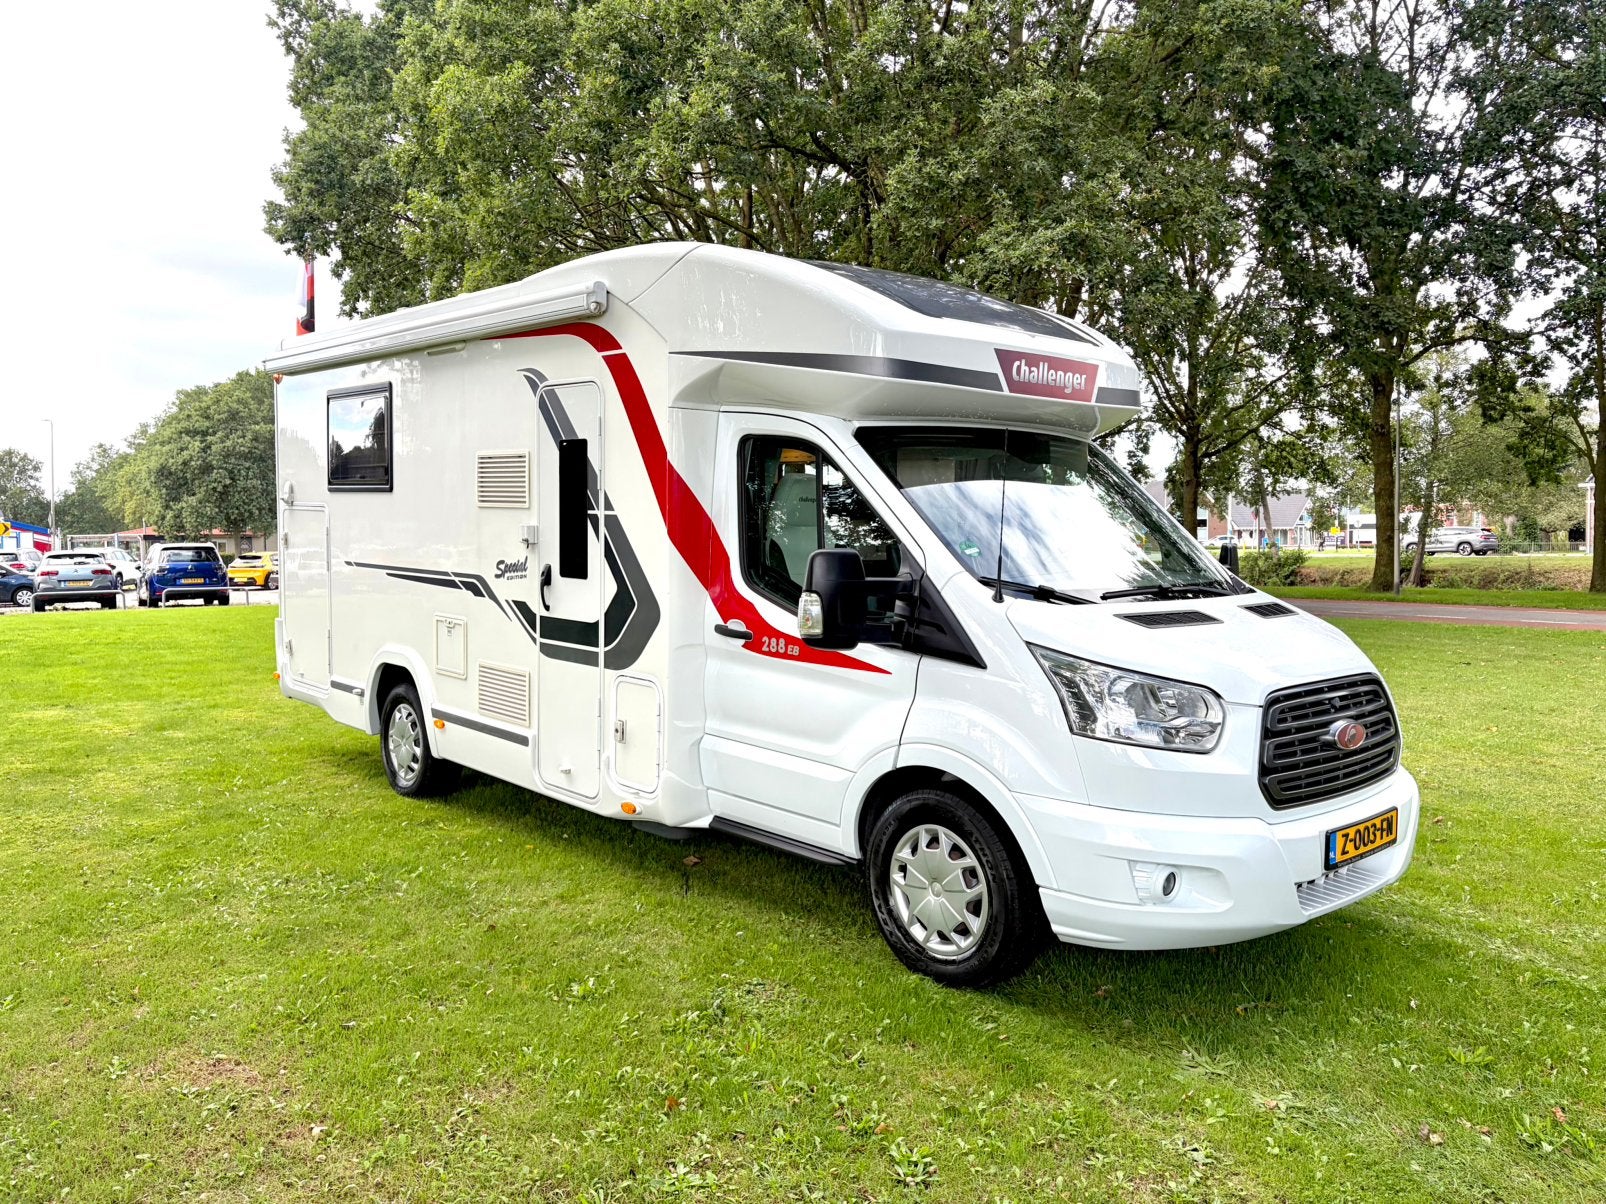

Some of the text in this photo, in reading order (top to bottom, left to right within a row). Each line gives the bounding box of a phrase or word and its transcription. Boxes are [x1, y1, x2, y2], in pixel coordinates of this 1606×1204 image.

[1012, 359, 1087, 394] Challenger
[494, 555, 529, 579] Special
[761, 636, 800, 656] 288 EB
[1340, 814, 1394, 856] Z-003-FN
